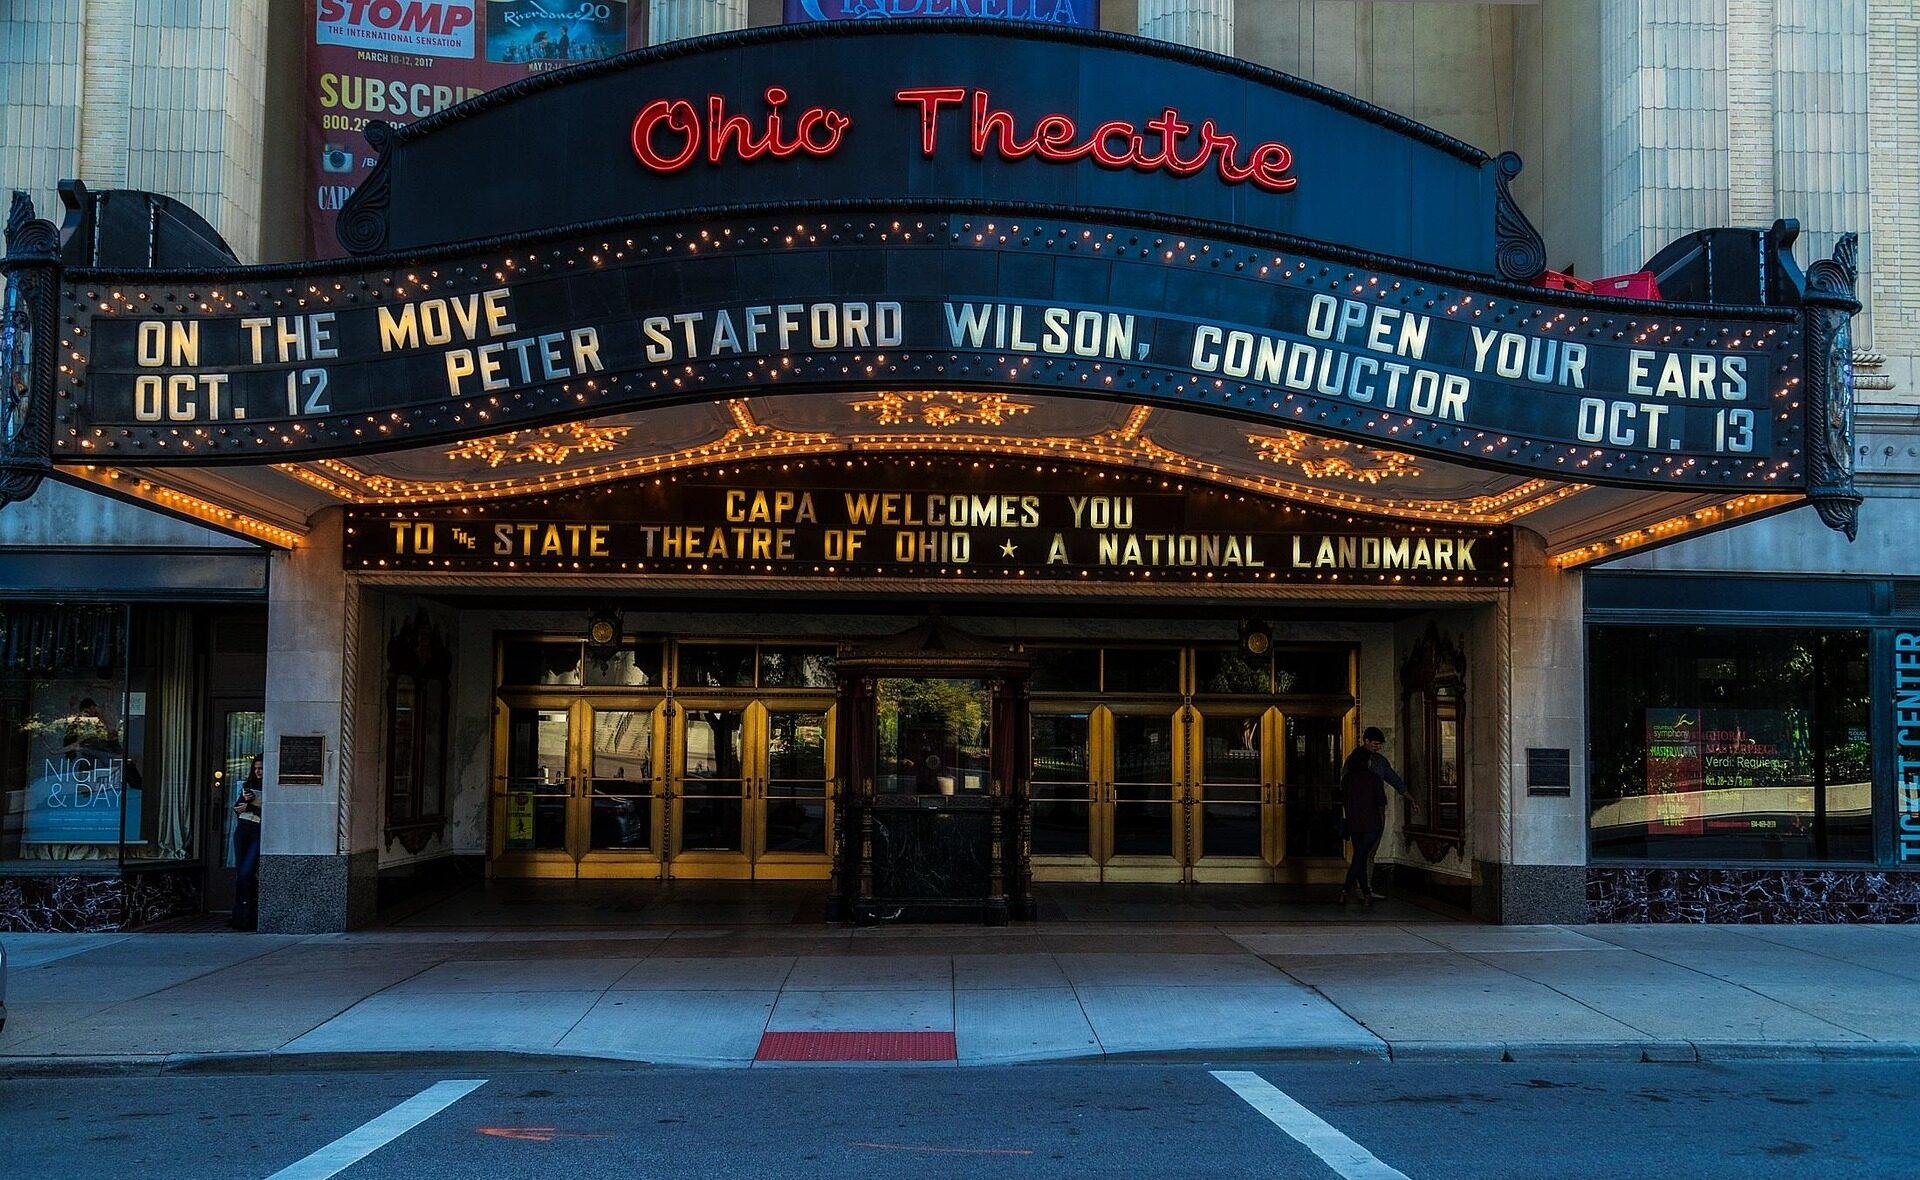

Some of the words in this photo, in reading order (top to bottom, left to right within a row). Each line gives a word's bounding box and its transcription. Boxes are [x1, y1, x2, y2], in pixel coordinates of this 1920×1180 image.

[318, 0, 473, 35] STOMP
[504, 0, 582, 27] Riverdance
[580, 2, 611, 22] 20
[328, 25, 343, 34] THE
[347, 28, 413, 44] INTERNATIONAL
[416, 36, 462, 48] SENSATION
[357, 51, 388, 63] MARCH
[391, 55, 413, 67] 10-12,
[414, 57, 433, 67] 2017
[528, 62, 543, 72] MAY
[320, 73, 486, 118] SUBSCRI
[630, 85, 851, 174] Ohio
[893, 86, 1298, 191] Theatre
[317, 186, 358, 210] CAP
[137, 320, 198, 367] ON
[241, 312, 339, 365] THE
[377, 287, 517, 353] MOVE
[444, 326, 604, 397] PETER
[642, 301, 902, 363] STAFFORD
[943, 302, 1150, 361] WILSON,
[1191, 324, 1471, 422] CONDUCTOR
[1306, 293, 1430, 360] OPEN
[1470, 325, 1588, 390] YOUR
[1627, 350, 1748, 402] EARS
[134, 373, 246, 422] OCT.
[286, 368, 331, 416] 12
[1576, 397, 1681, 450] OCT.
[1715, 408, 1755, 454] 13
[726, 489, 818, 524] CAPA
[845, 493, 1040, 528] WELCOMES
[1067, 496, 1134, 529] YOU
[390, 521, 435, 555] TO
[451, 527, 476, 550] THE
[494, 523, 610, 558] STATE
[640, 525, 796, 561] THEATRE
[824, 528, 863, 562] OF
[895, 531, 971, 564] OHIO
[1046, 533, 1070, 565] A
[1099, 533, 1265, 568] NATIONAL
[1292, 536, 1477, 571] LANDMARK
[1895, 632, 1920, 746] CENTER
[1650, 745, 1697, 758] MASTERWORKS
[1653, 729, 1690, 739] symphony
[45, 758, 132, 782] NIGHT
[1706, 756, 1735, 768] Verdi:
[47, 783, 67, 807] &
[75, 783, 122, 807] DAY
